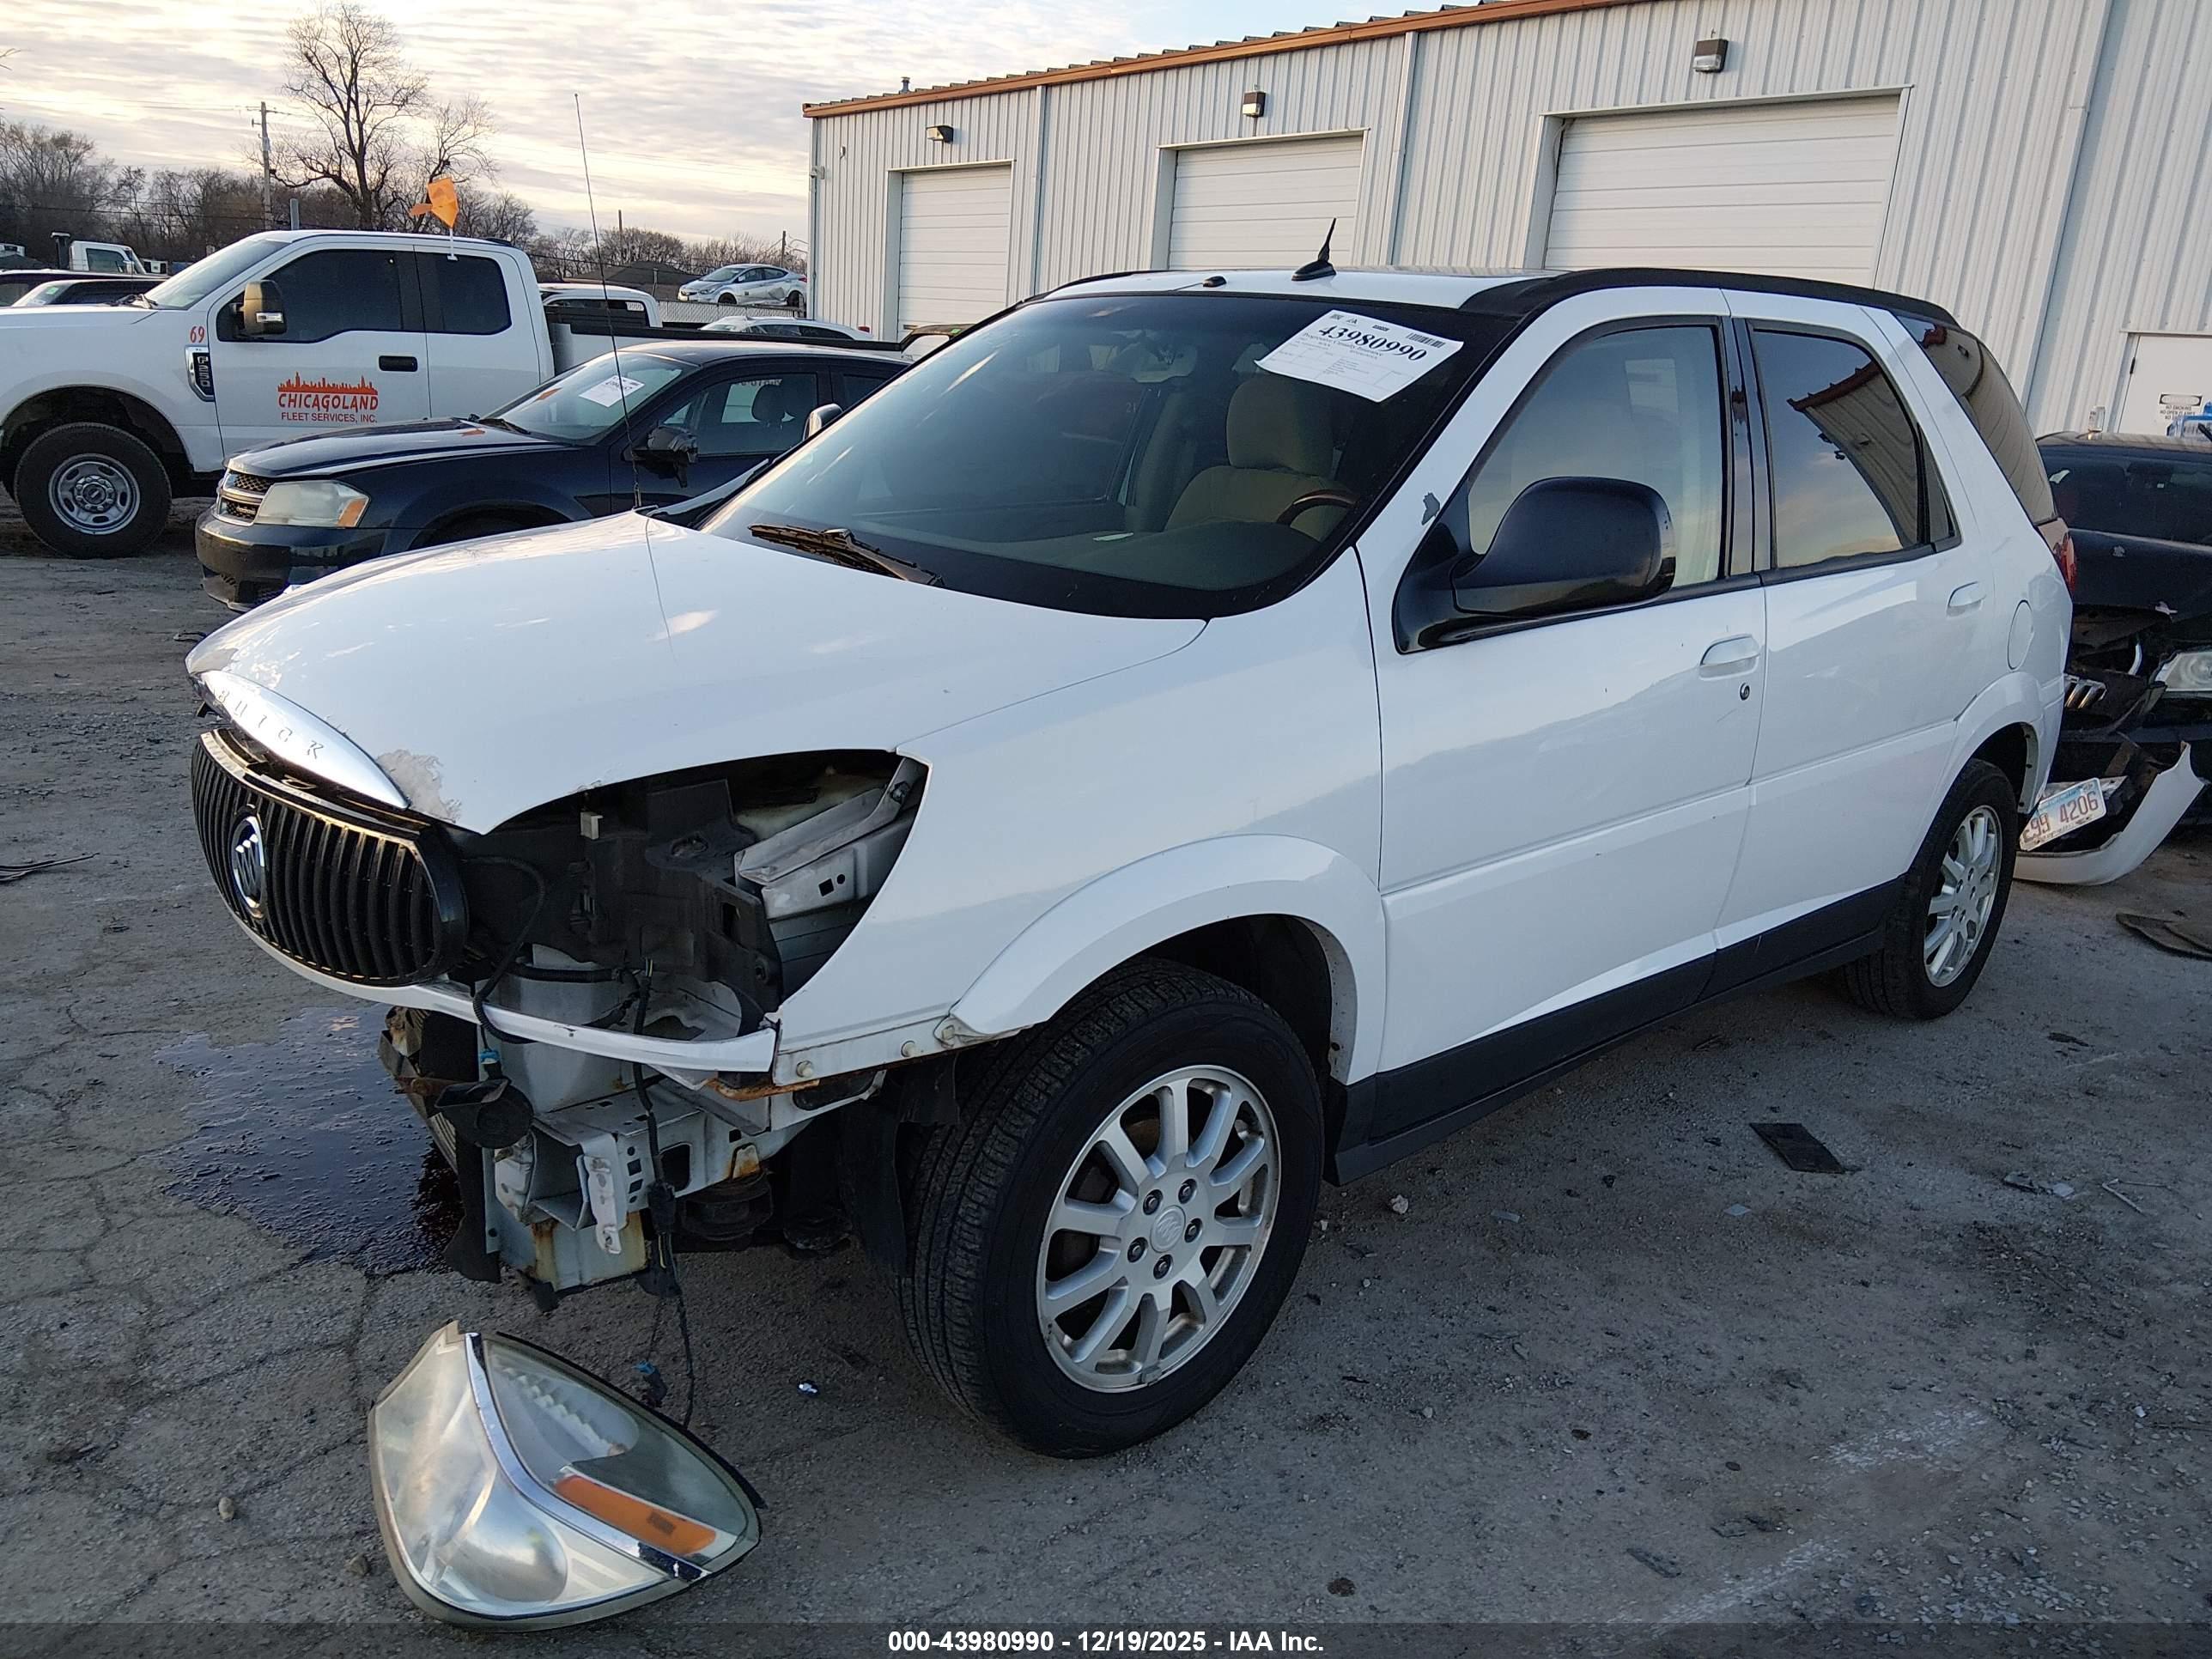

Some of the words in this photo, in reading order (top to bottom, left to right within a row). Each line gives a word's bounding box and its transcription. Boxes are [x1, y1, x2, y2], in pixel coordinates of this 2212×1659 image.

[191, 326, 205, 343] 69
[1319, 325, 1427, 361] 43980990
[278, 393, 379, 412] CHICAGOLAND
[282, 412, 309, 421] FLEET
[361, 414, 378, 422] INC.
[218, 690, 324, 759] BUICK
[2060, 791, 2099, 823] 4206
